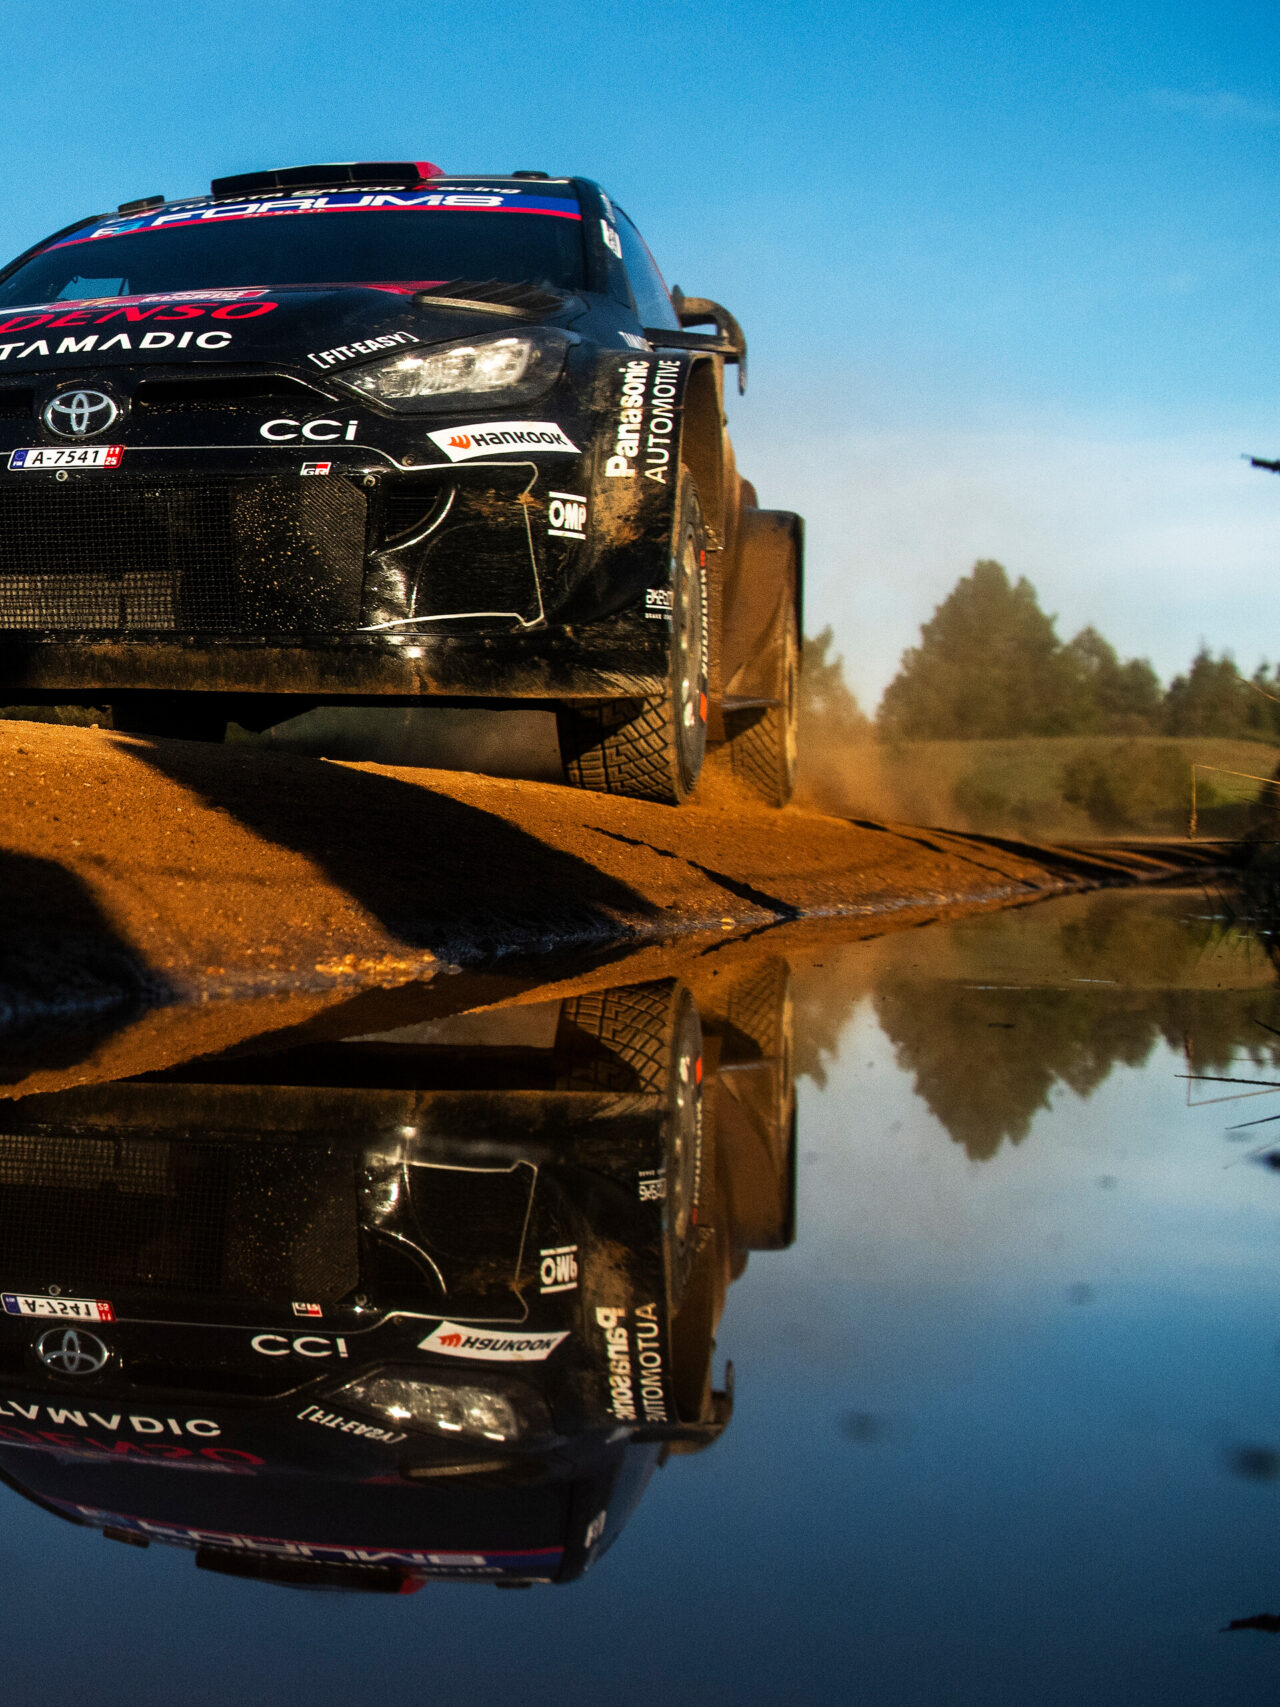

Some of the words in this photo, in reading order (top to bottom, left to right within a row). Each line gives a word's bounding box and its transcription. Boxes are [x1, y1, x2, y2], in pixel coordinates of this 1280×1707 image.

[151, 194, 504, 226] FORUM8
[604, 360, 650, 478] Panasonic
[644, 360, 681, 484] AUTOMOTIVE
[31, 450, 100, 465] A-7541
[104, 457, 117, 466] 25
[548, 500, 587, 531] OMP
